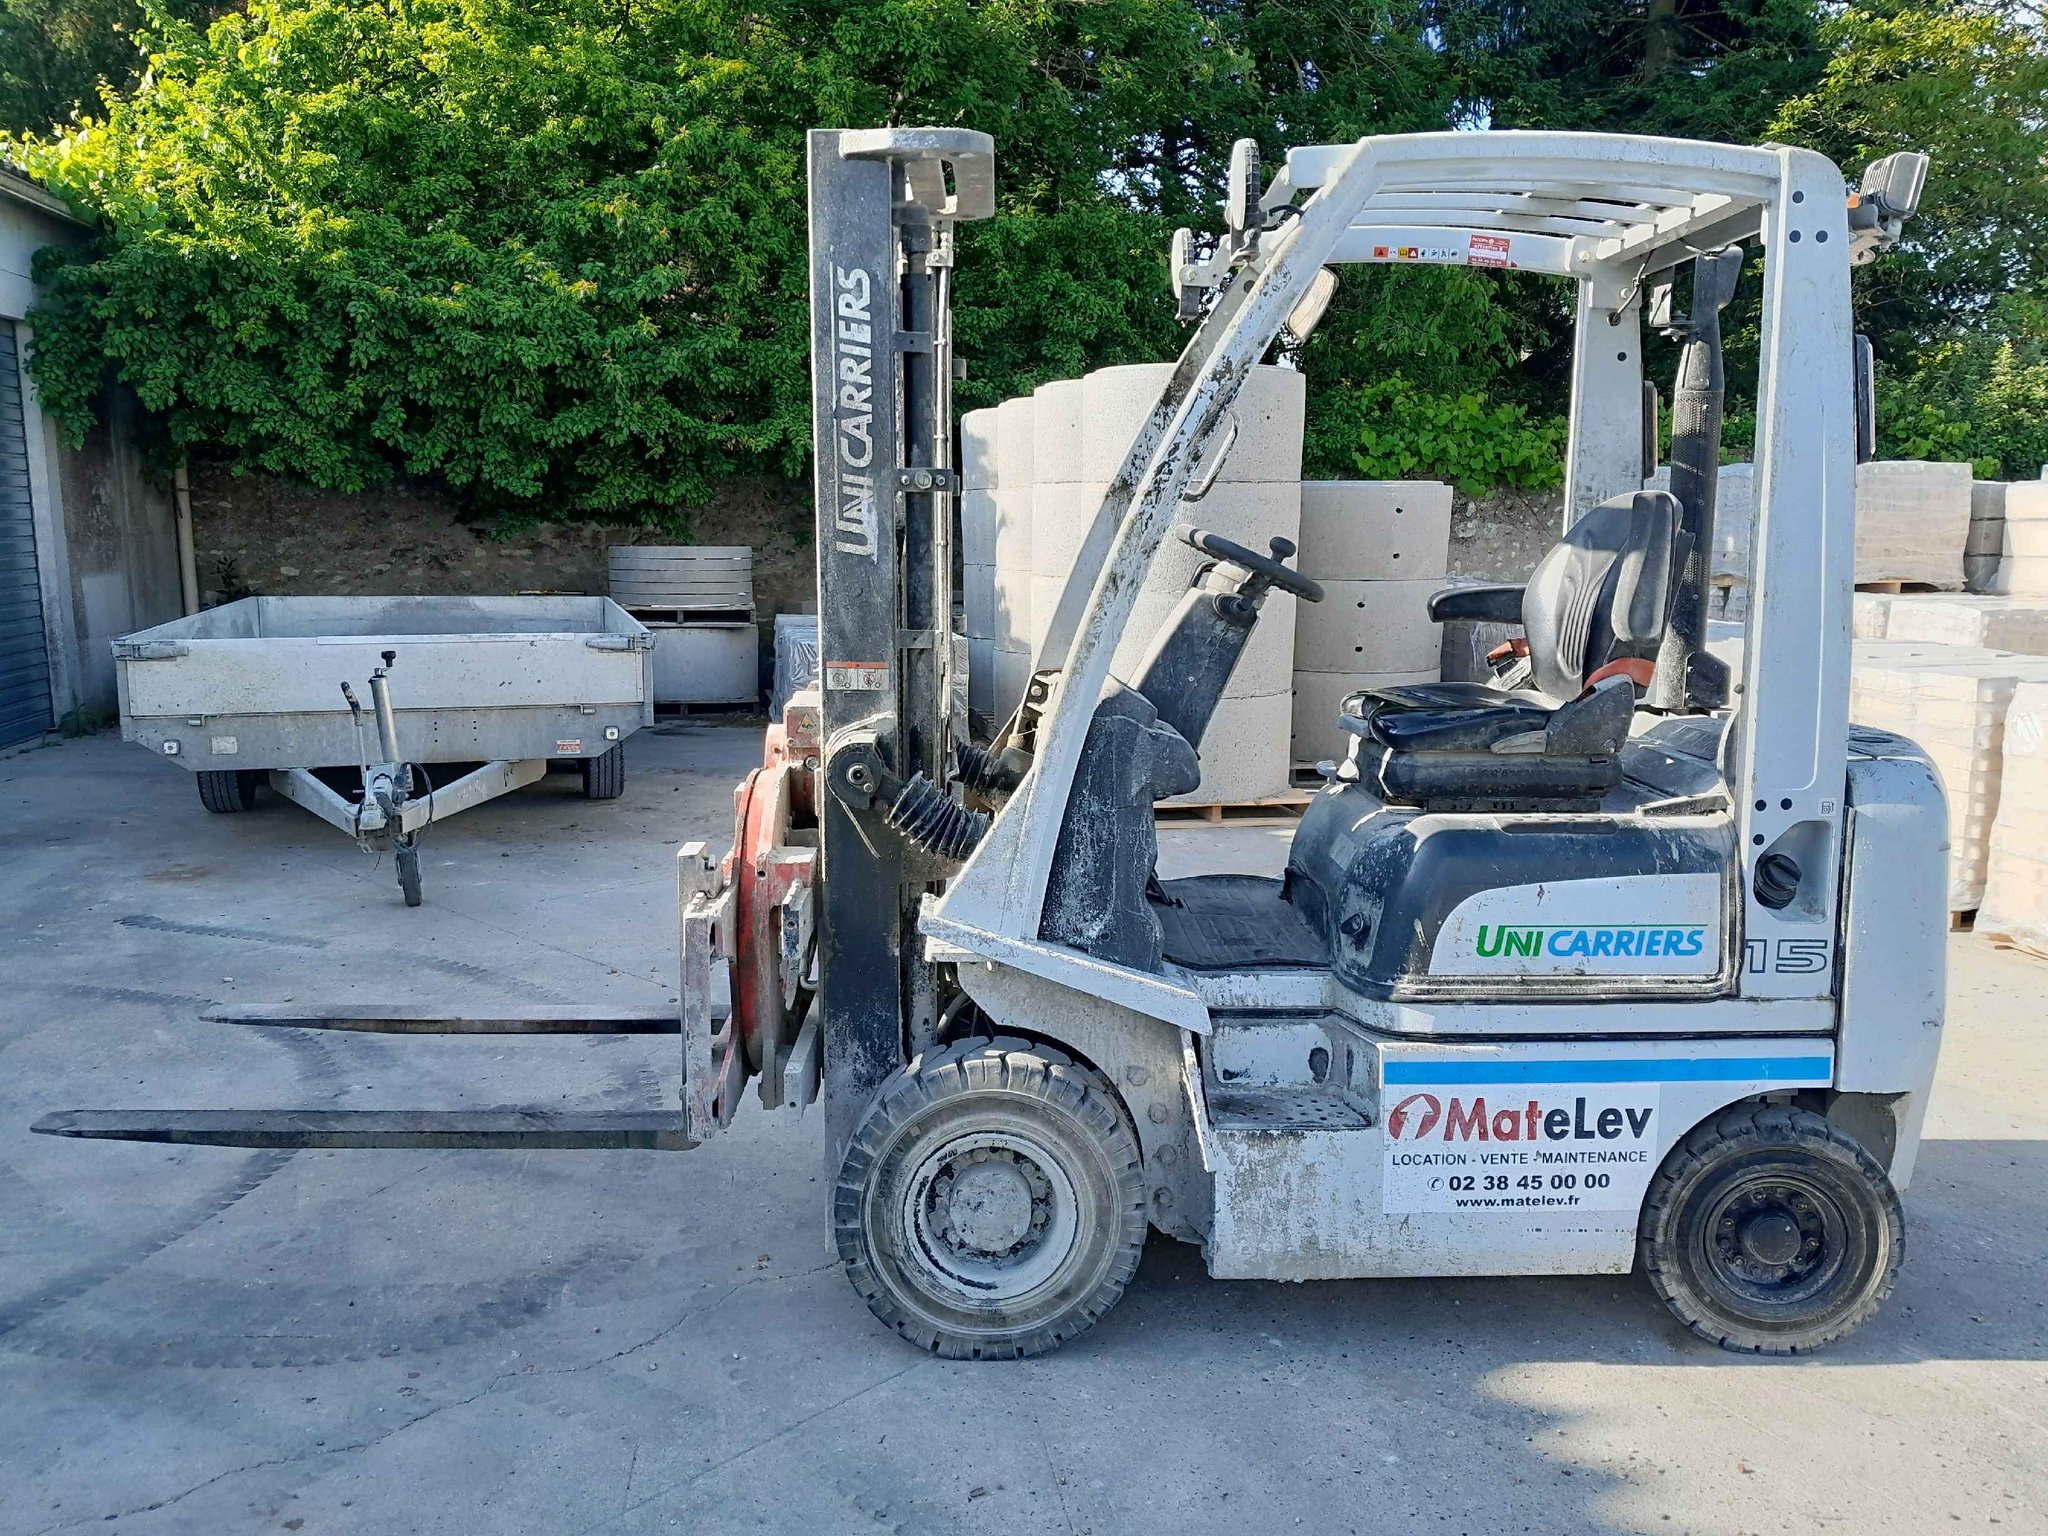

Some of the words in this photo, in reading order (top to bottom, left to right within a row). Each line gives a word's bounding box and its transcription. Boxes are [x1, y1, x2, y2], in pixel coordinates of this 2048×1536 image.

[1744, 938, 1828, 974] 15
[1443, 1097, 1653, 1142] MateLev
[1391, 1152, 1467, 1166] LOCATION
[1480, 1152, 1529, 1165] VENTE
[1541, 1150, 1648, 1164] MAINTENANCE
[1449, 1175, 1475, 1191] 02
[1483, 1175, 1509, 1191] 38
[1516, 1174, 1543, 1190] 45
[1550, 1173, 1577, 1190] 00
[1584, 1173, 1610, 1189] 00
[1455, 1195, 1581, 1208] www.matelev.fr
